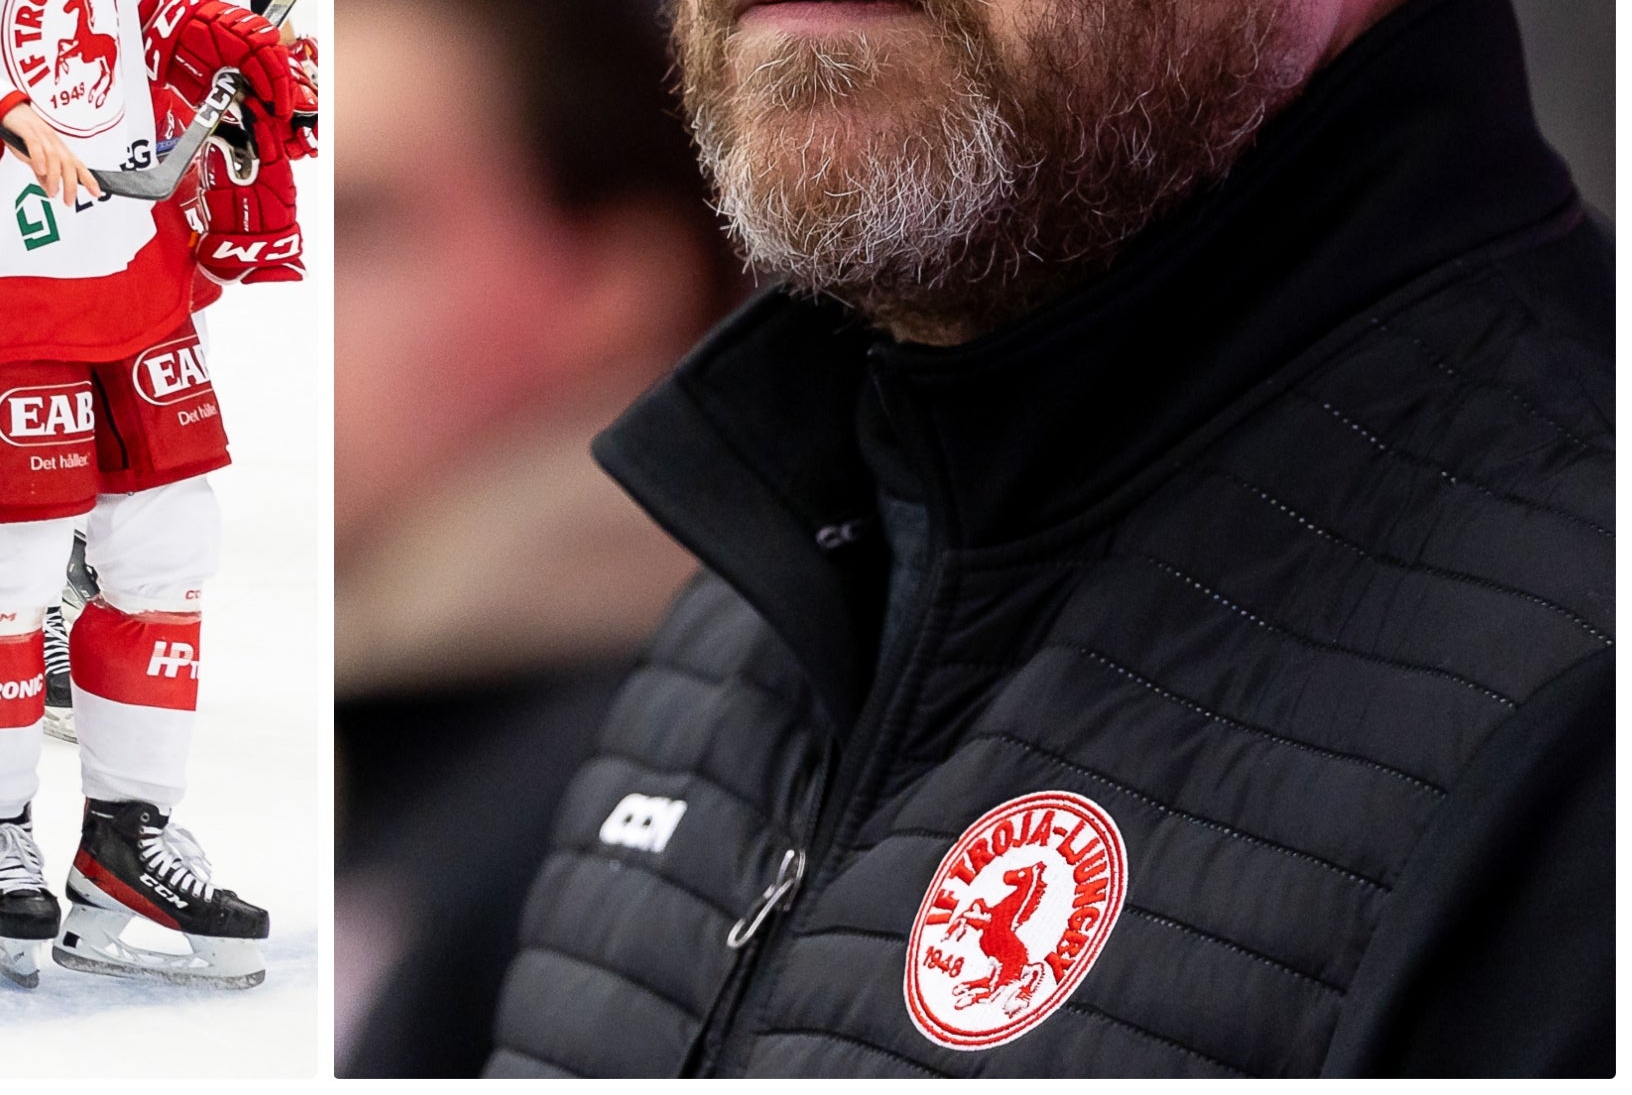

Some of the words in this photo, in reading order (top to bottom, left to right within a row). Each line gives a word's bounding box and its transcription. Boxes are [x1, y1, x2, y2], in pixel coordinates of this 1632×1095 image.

[19, 54, 51, 88] IF
[8, 391, 96, 438] EAB
[177, 410, 200, 427] Det
[29, 455, 57, 471] Det
[138, 872, 189, 910] CCM
[925, 888, 959, 927] IF
[948, 809, 1112, 986] TROJA-LJUNGBY
[922, 944, 966, 979] 1948
